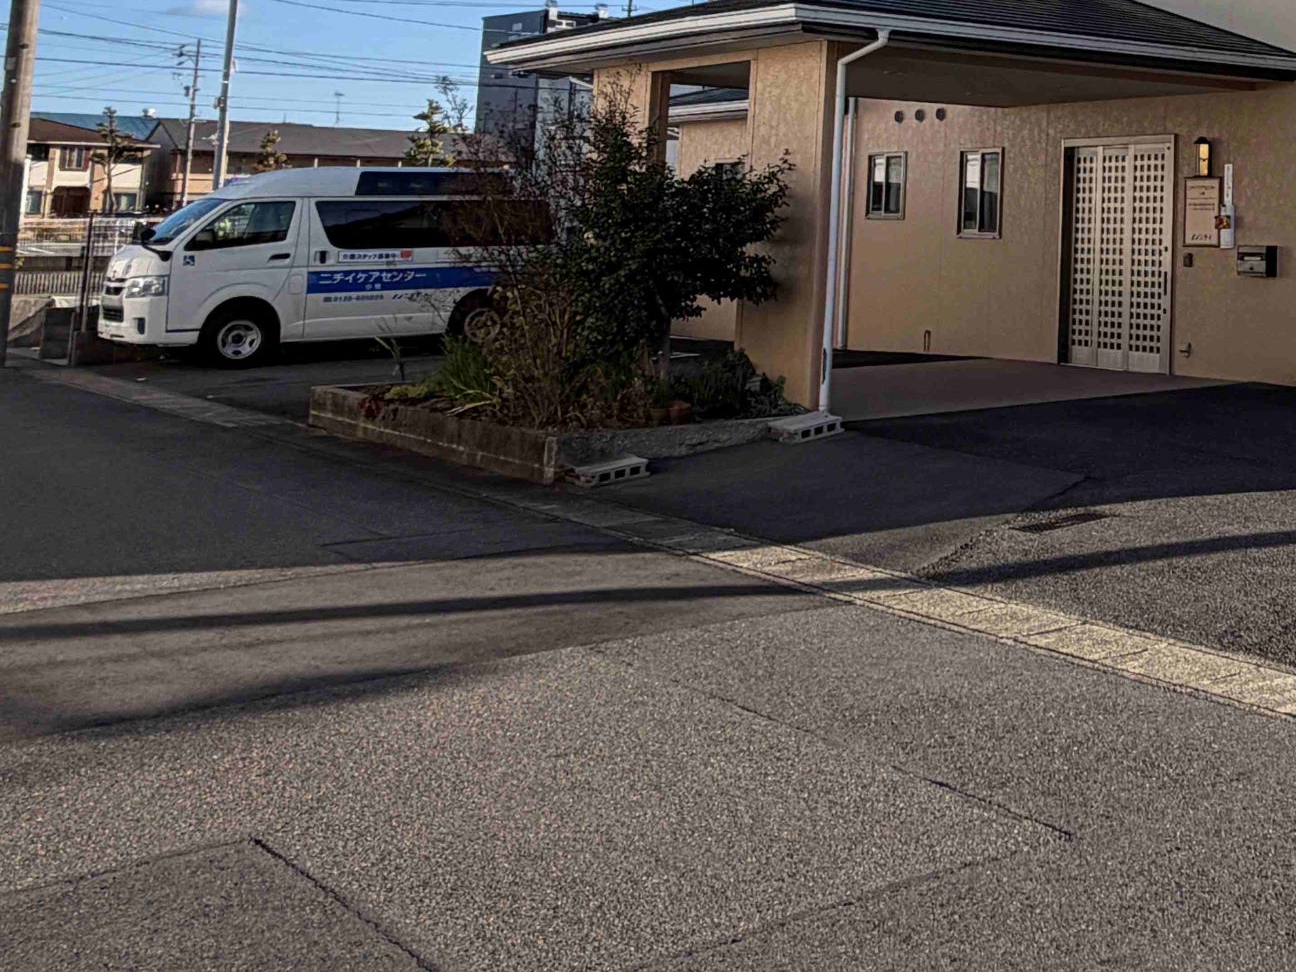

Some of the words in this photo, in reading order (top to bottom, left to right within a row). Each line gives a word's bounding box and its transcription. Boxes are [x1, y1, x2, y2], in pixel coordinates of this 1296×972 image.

[319, 271, 427, 284] ニチイケアセンター
